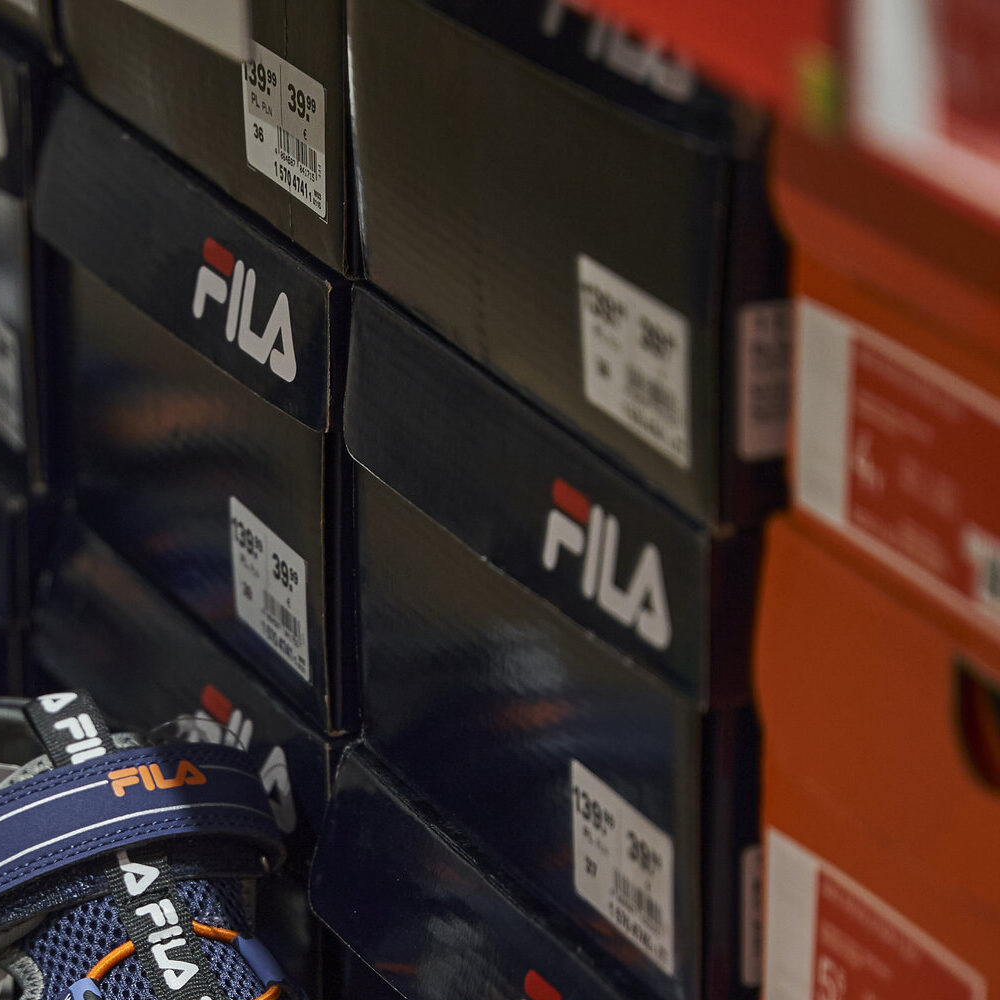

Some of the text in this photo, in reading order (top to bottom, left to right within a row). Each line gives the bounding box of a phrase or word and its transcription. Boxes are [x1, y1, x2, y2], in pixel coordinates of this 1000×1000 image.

[253, 123, 264, 143] 36
[288, 83, 316, 122] 39.99
[193, 237, 297, 382] FILA
[542, 477, 672, 651] FILA
[108, 760, 207, 797] FILA
[135, 899, 199, 990] FILA
